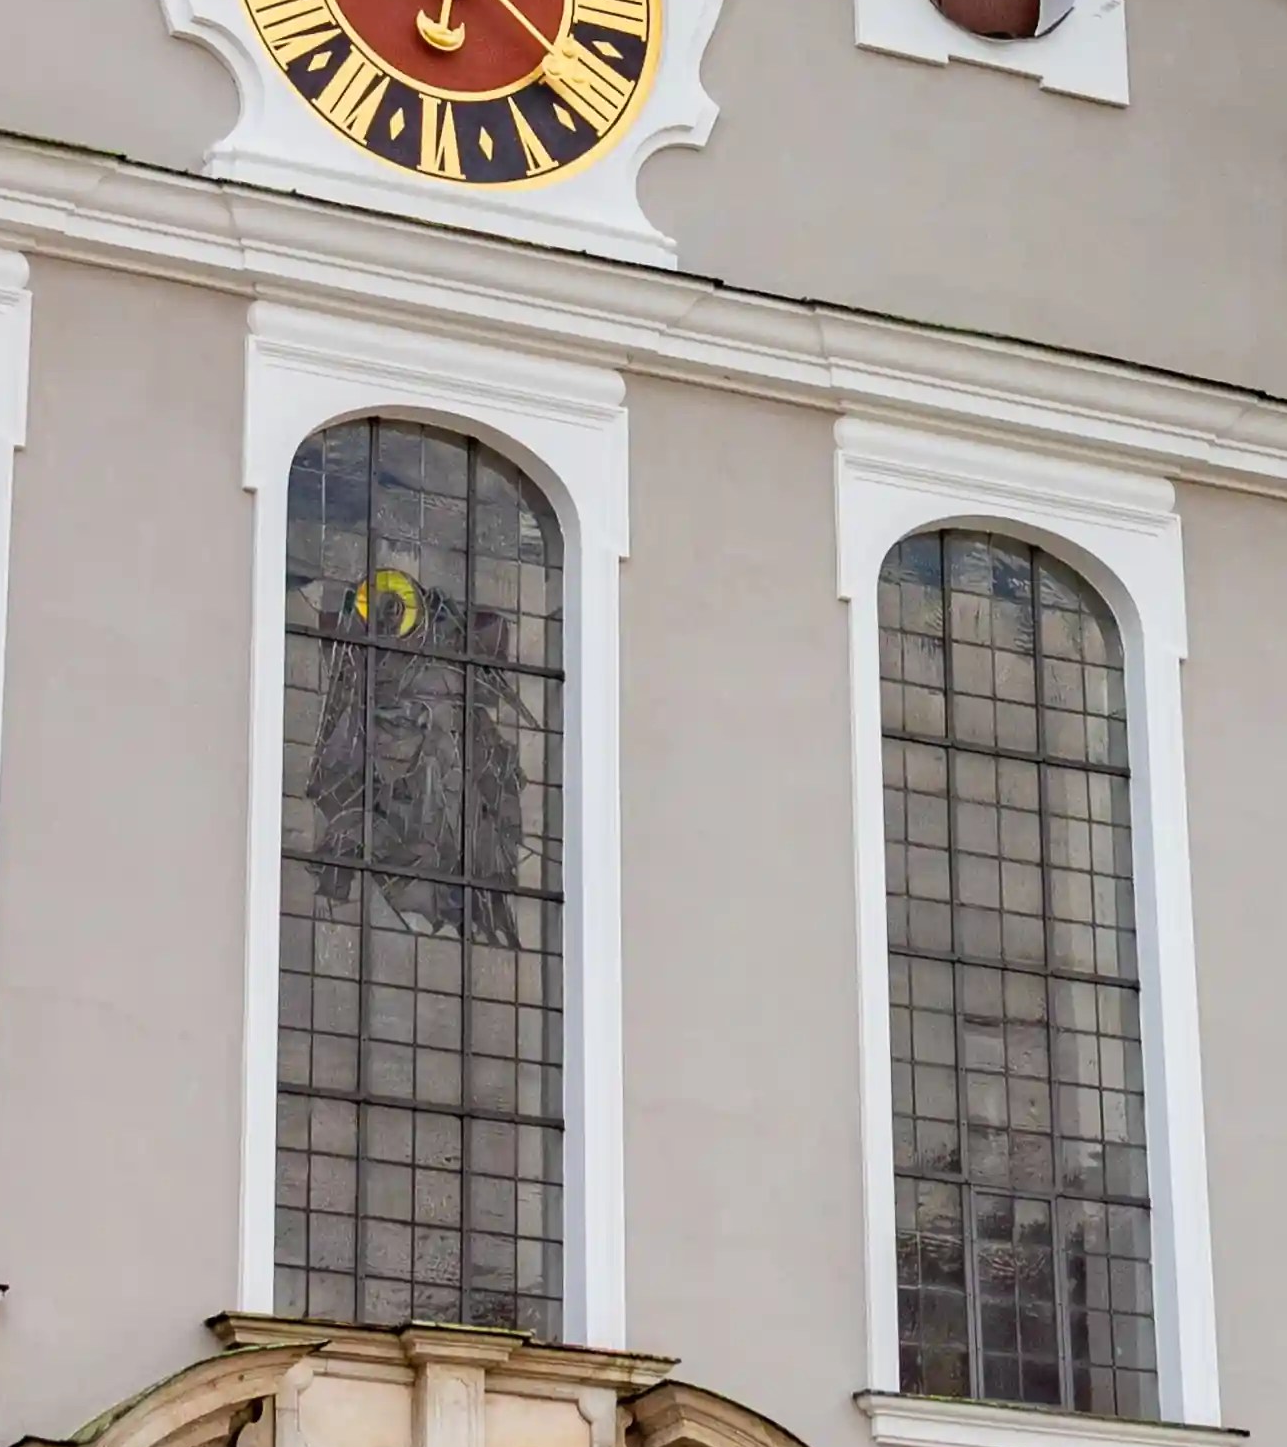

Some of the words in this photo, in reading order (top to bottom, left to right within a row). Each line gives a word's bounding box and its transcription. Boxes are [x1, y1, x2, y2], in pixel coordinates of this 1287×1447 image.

[312, 44, 391, 145] VII
[417, 92, 467, 180] VI
[508, 95, 560, 176] V
